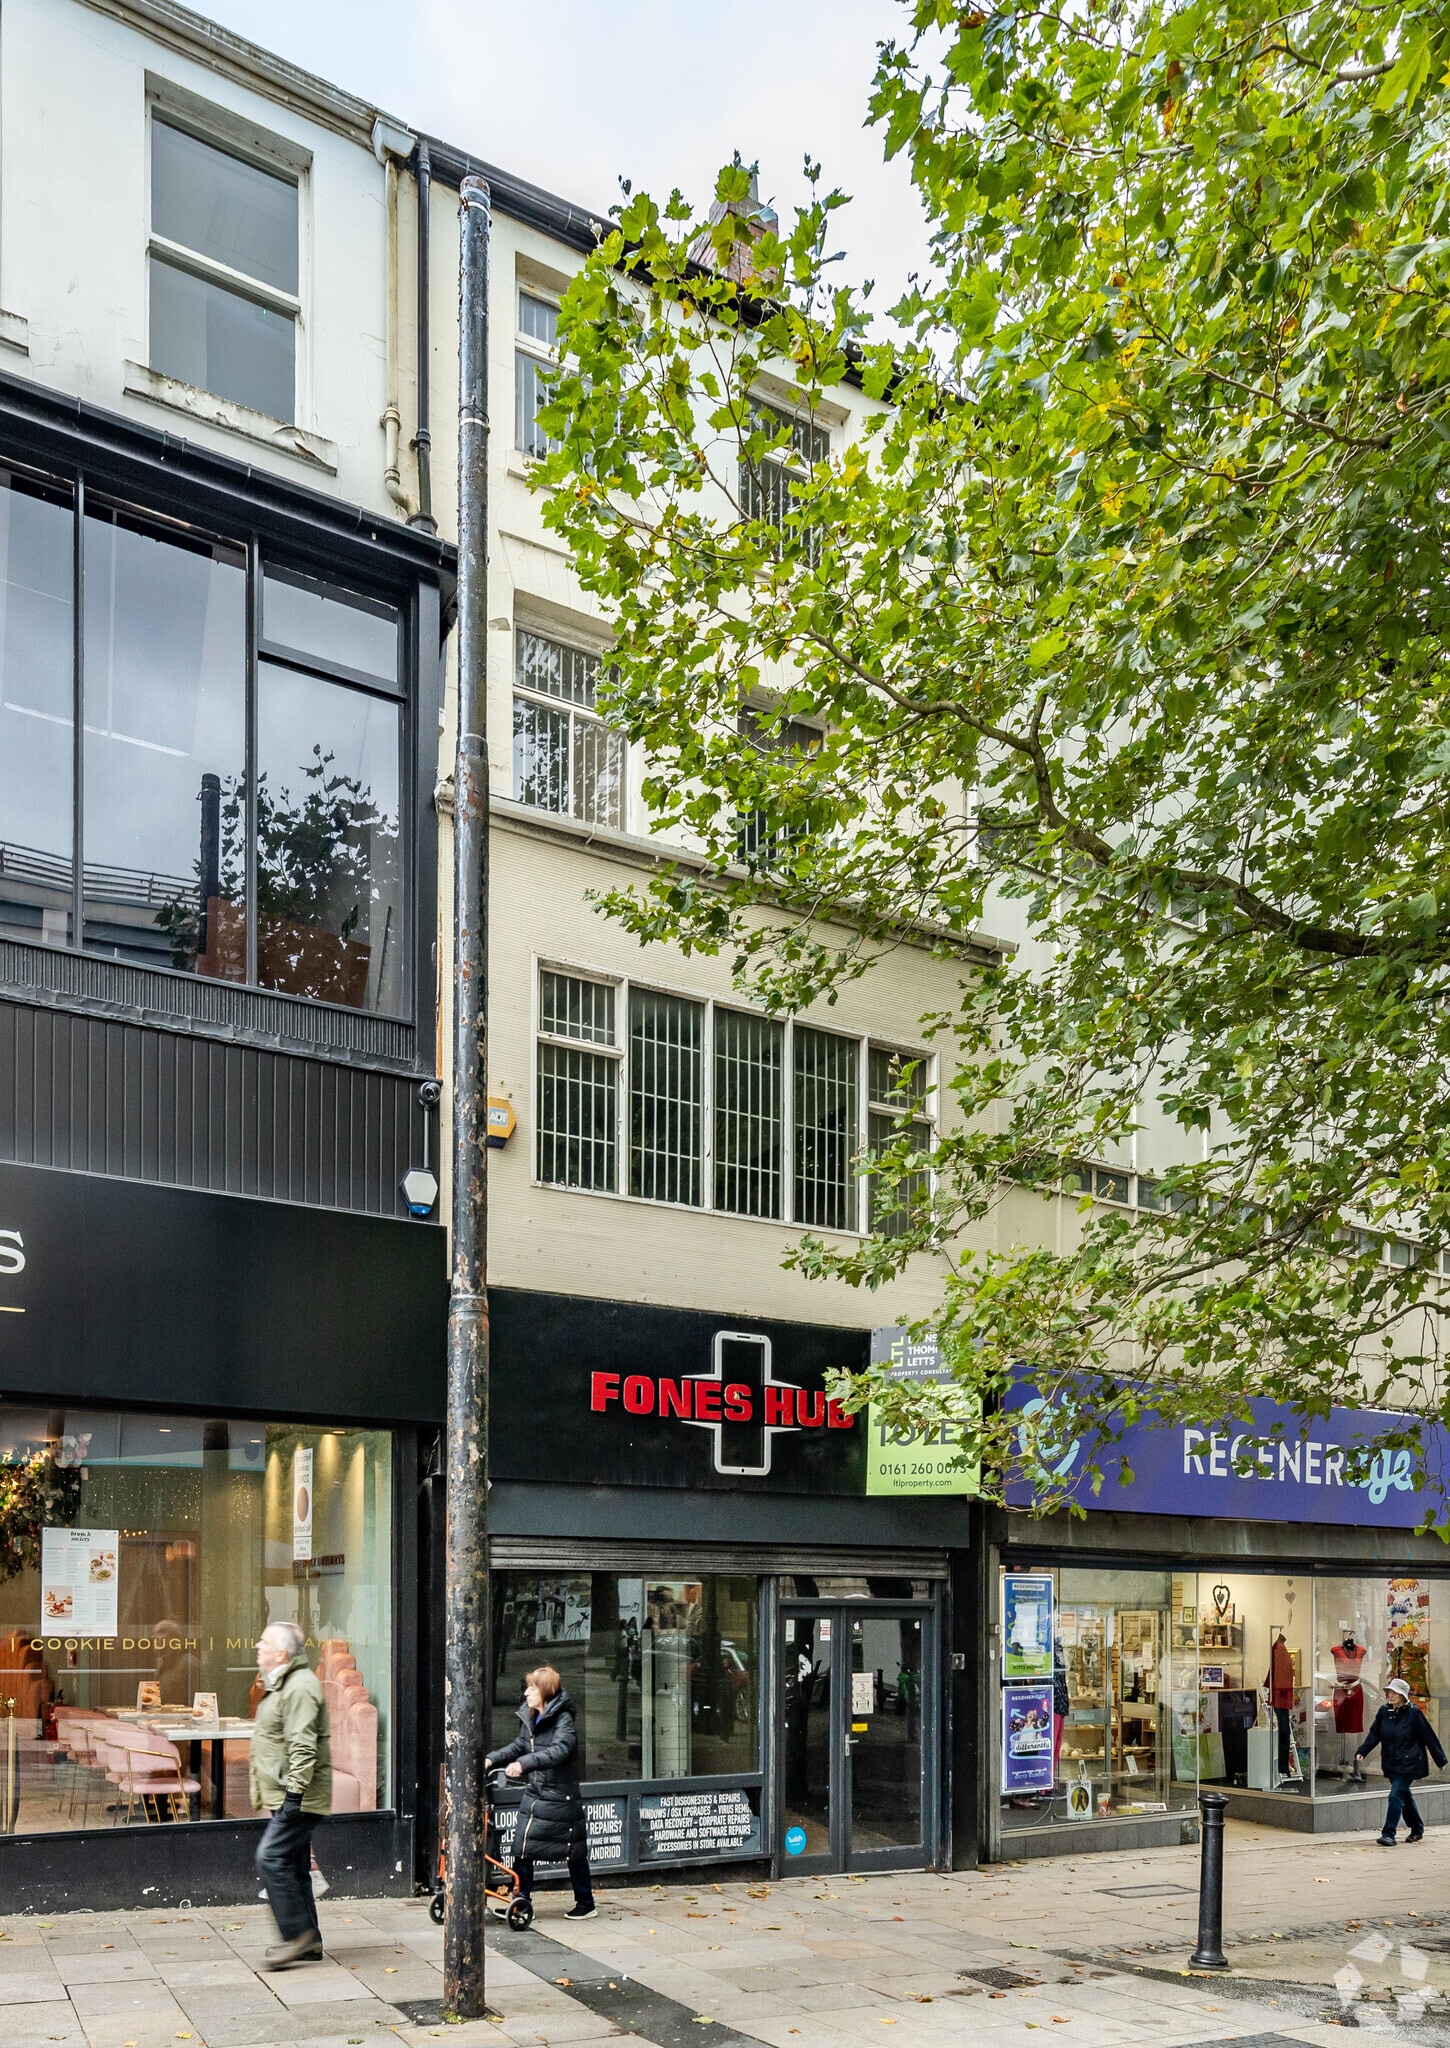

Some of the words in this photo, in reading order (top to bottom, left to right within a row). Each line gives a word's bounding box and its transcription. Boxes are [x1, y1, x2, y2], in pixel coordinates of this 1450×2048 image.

[489, 1111, 507, 1123] ADT
[907, 1333, 938, 1344] LNS
[907, 1345, 938, 1356] THOM
[907, 1356, 935, 1367] LETTS
[591, 1371, 753, 1421] FONES
[764, 1386, 855, 1429] HUB
[874, 1420, 916, 1447] TO
[880, 1463, 906, 1475] 0161
[911, 1462, 933, 1475] 260
[893, 1479, 952, 1488] ltlproperty.com
[30, 1638, 115, 1651] COOKIE
[122, 1637, 197, 1650] DOUGH
[660, 1796, 674, 1807] FAST
[719, 1793, 741, 1803] REPAIRS
[587, 1803, 618, 1821] PHONE,
[639, 1807, 666, 1819] WINDOWS
[671, 1807, 682, 1817] OSX
[683, 1805, 711, 1816] UPGRADES
[717, 1804, 734, 1815] VIRUS
[735, 1803, 752, 1814] REMO
[590, 1820, 623, 1835] REPAIRS?
[650, 1820, 664, 1830] DATA
[665, 1818, 693, 1829] RECOVERY
[728, 1814, 750, 1824] REPAIRS
[654, 1829, 685, 1841] HARDWARE
[686, 1828, 698, 1839] AND
[699, 1826, 728, 1837] SOFTWARE
[729, 1825, 751, 1835] REPAIRS
[657, 1840, 692, 1852] ACCESSORIES
[693, 1840, 699, 1850] IN
[700, 1838, 716, 1849] STORE
[716, 1837, 743, 1848] AVAILABLE
[590, 1845, 621, 1861] ANDRIOD
